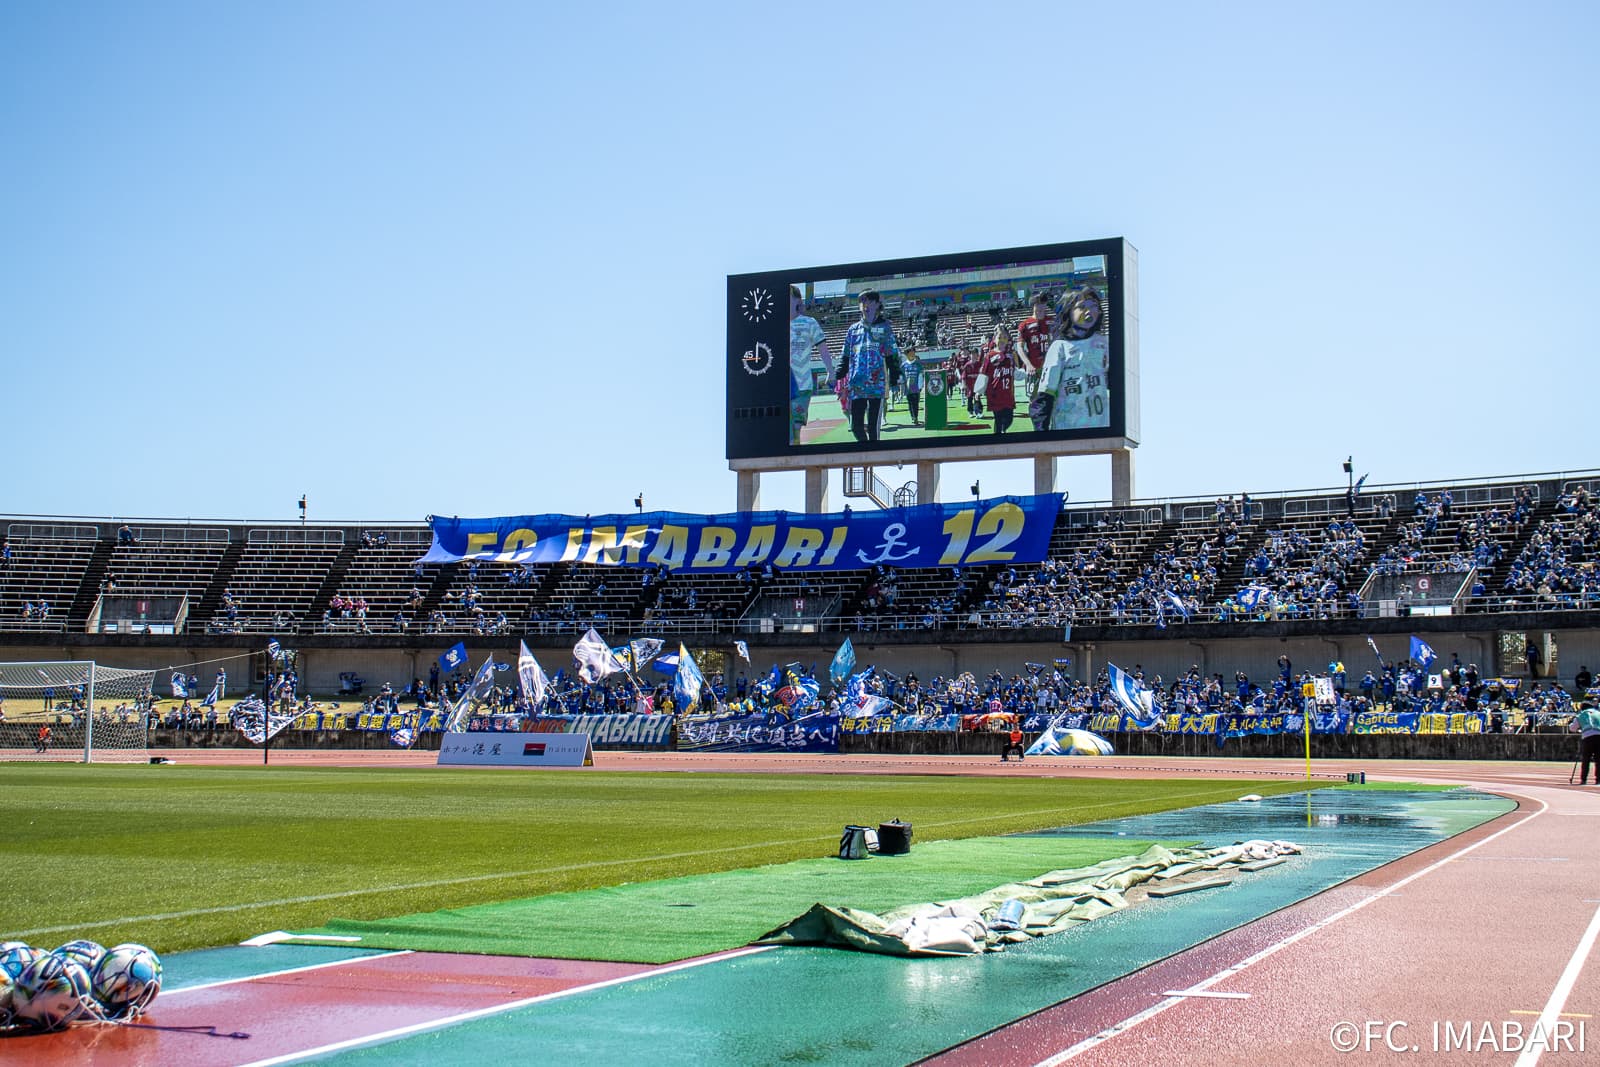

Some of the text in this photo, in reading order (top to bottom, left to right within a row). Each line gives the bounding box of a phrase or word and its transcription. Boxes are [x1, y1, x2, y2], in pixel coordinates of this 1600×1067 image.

[1002, 378, 1009, 389] 12
[1026, 382, 1034, 393] 16
[1085, 394, 1104, 417] 10
[559, 525, 848, 570] IMABARI
[938, 502, 1026, 565] 12
[1418, 579, 1429, 589] G
[795, 600, 803, 609] H
[1431, 677, 1437, 685] 9
[568, 715, 672, 743] IMABARI
